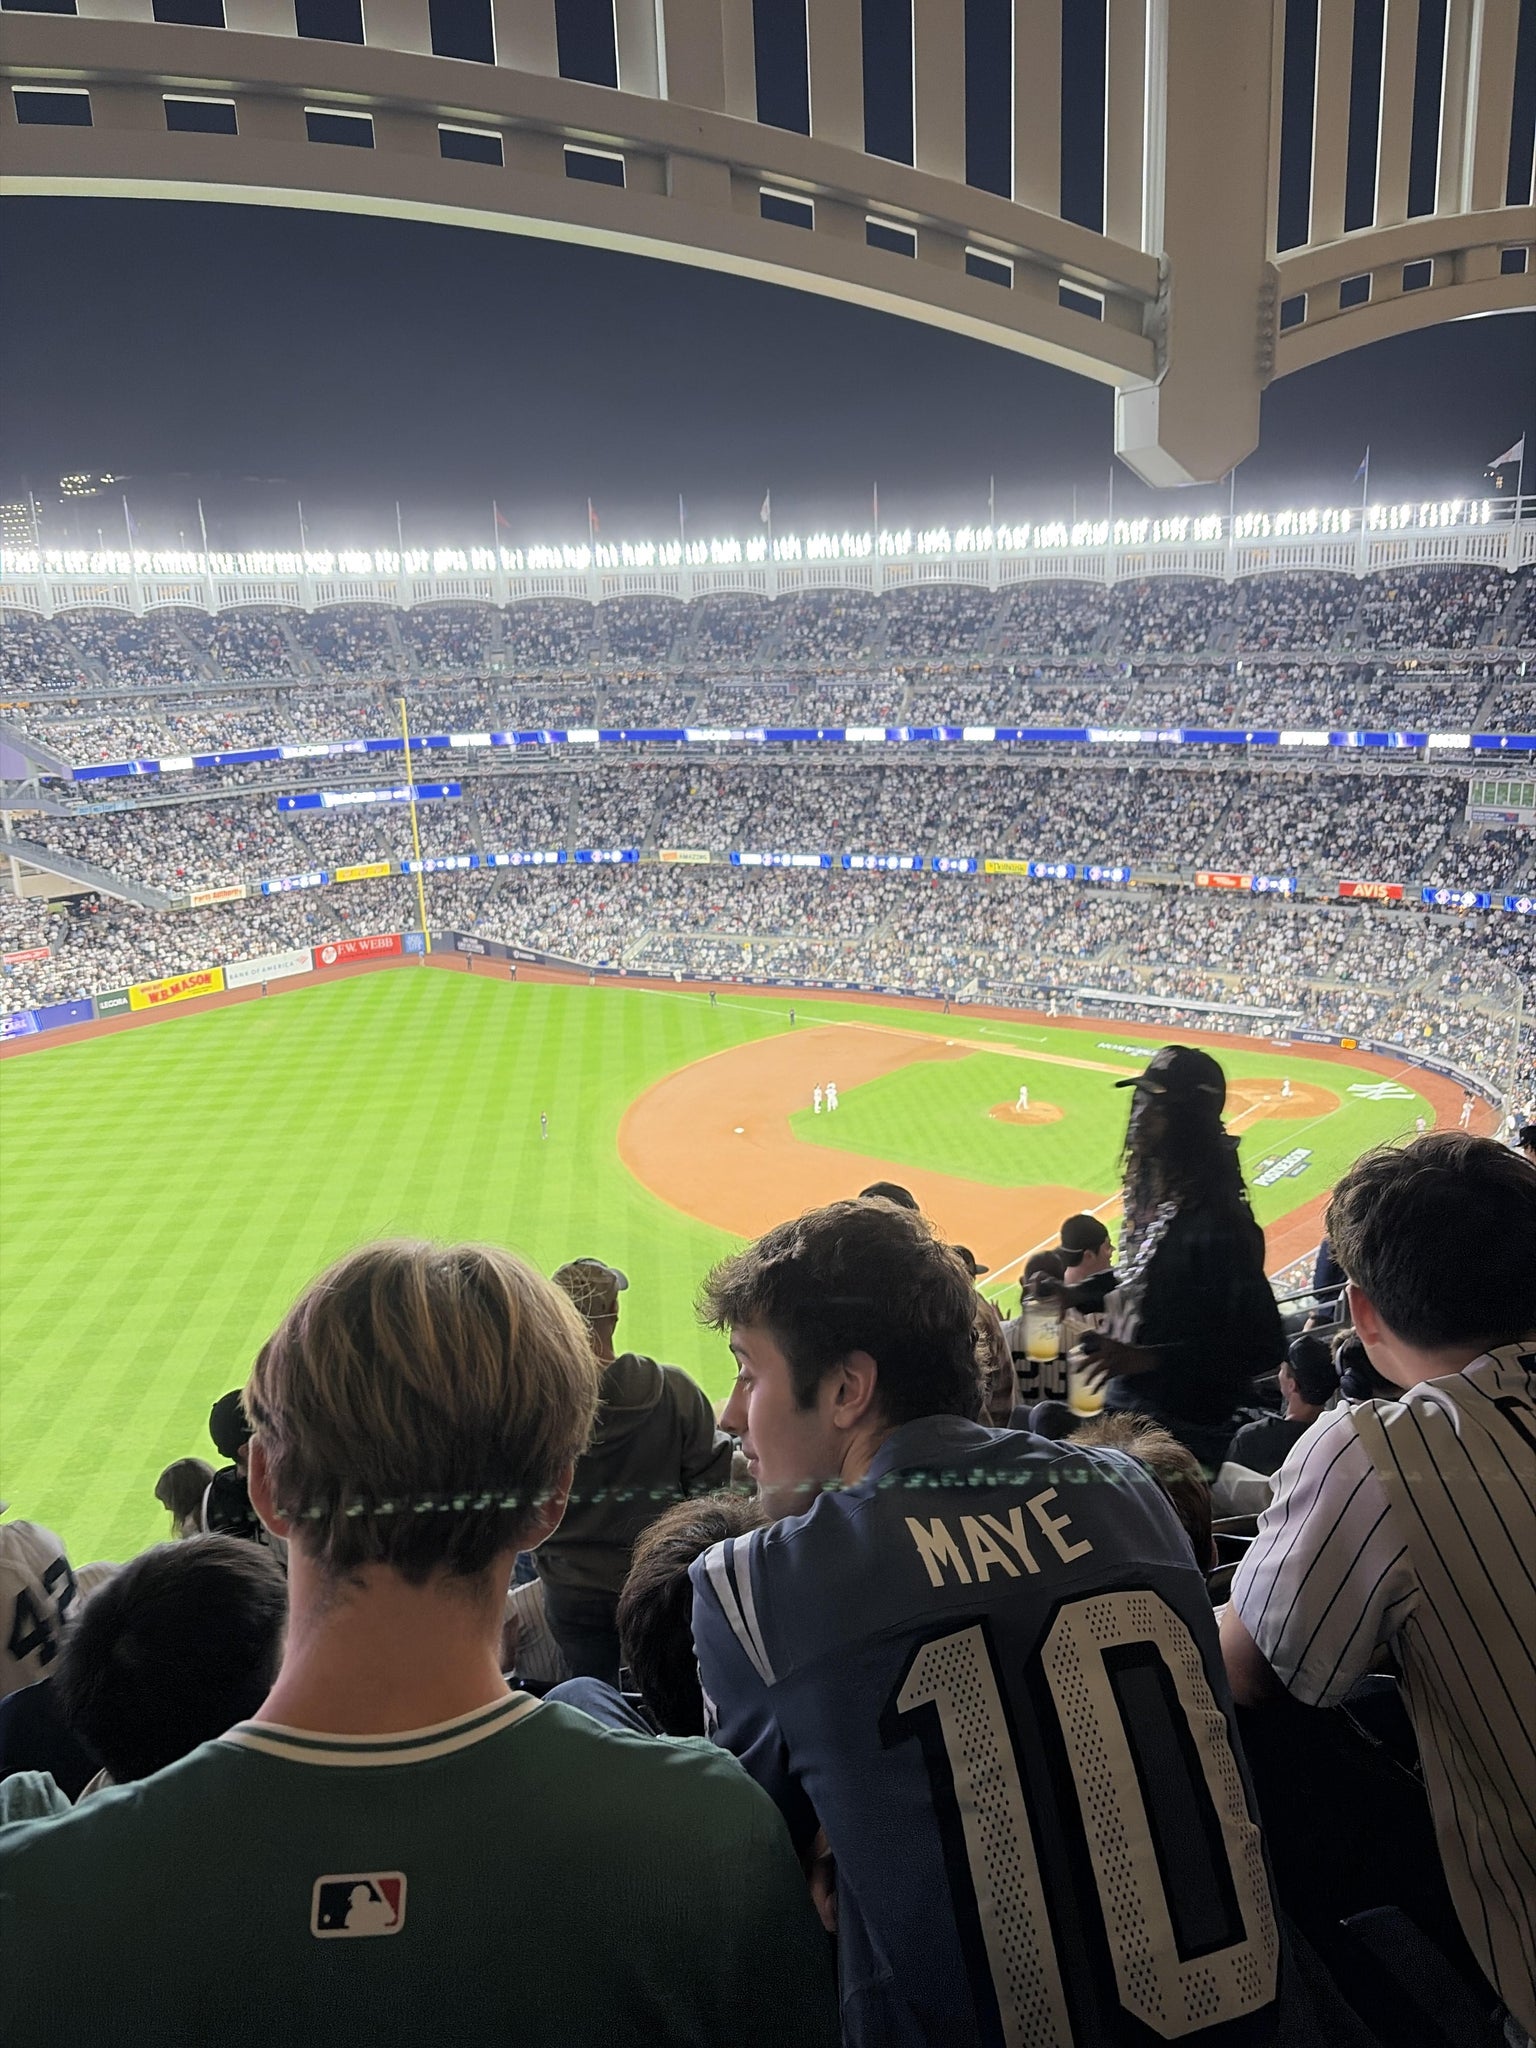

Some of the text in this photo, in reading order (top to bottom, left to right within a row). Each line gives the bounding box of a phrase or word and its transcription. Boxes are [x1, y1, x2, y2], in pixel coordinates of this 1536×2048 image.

[1352, 883, 1388, 897] AVIS
[338, 937, 394, 955] F.W. WEBB
[229, 970, 249, 980] BANK
[262, 961, 294, 973] AMERICA
[1252, 1147, 1313, 1187] POSTSEASON
[905, 1487, 1094, 1587] MAYE
[882, 1582, 1283, 2048] 10
